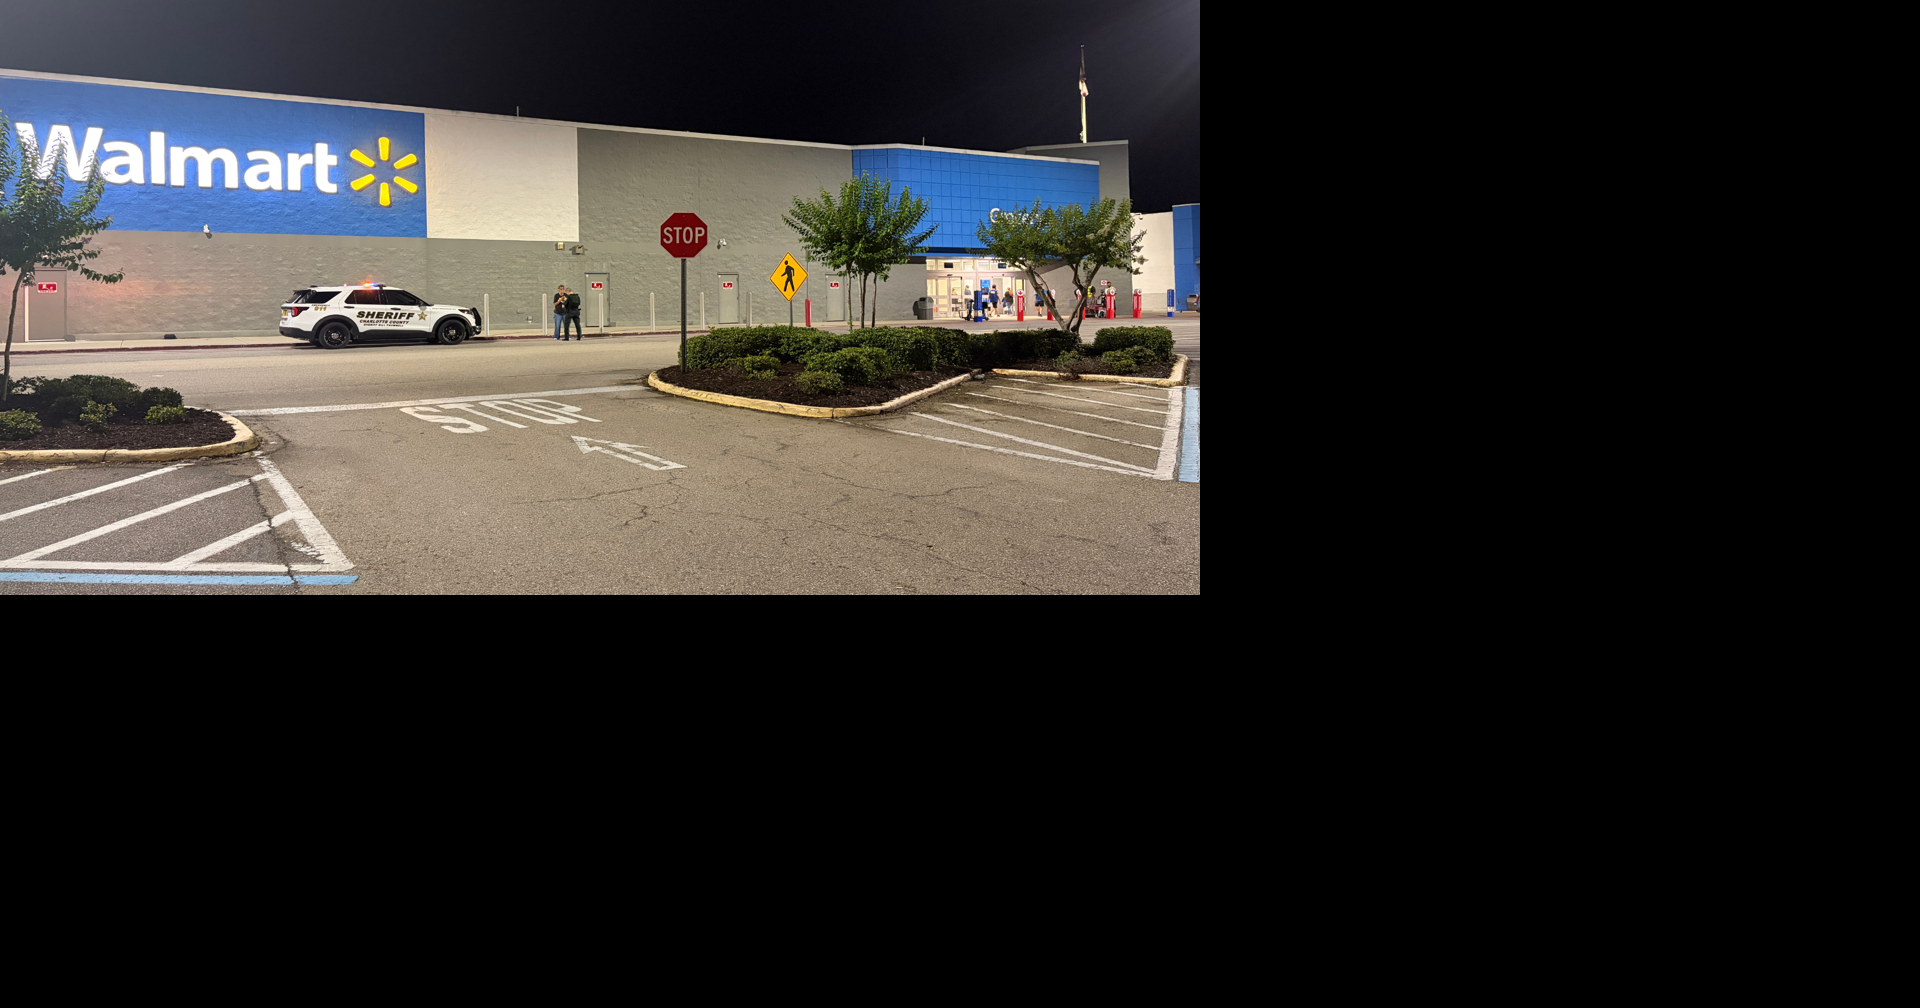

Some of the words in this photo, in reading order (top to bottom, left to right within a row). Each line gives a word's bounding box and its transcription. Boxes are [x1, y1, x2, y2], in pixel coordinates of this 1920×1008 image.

[15, 122, 339, 194] Walmart
[663, 226, 705, 244] STOP
[356, 310, 415, 320] SHERIFF
[399, 398, 603, 434] STOP
